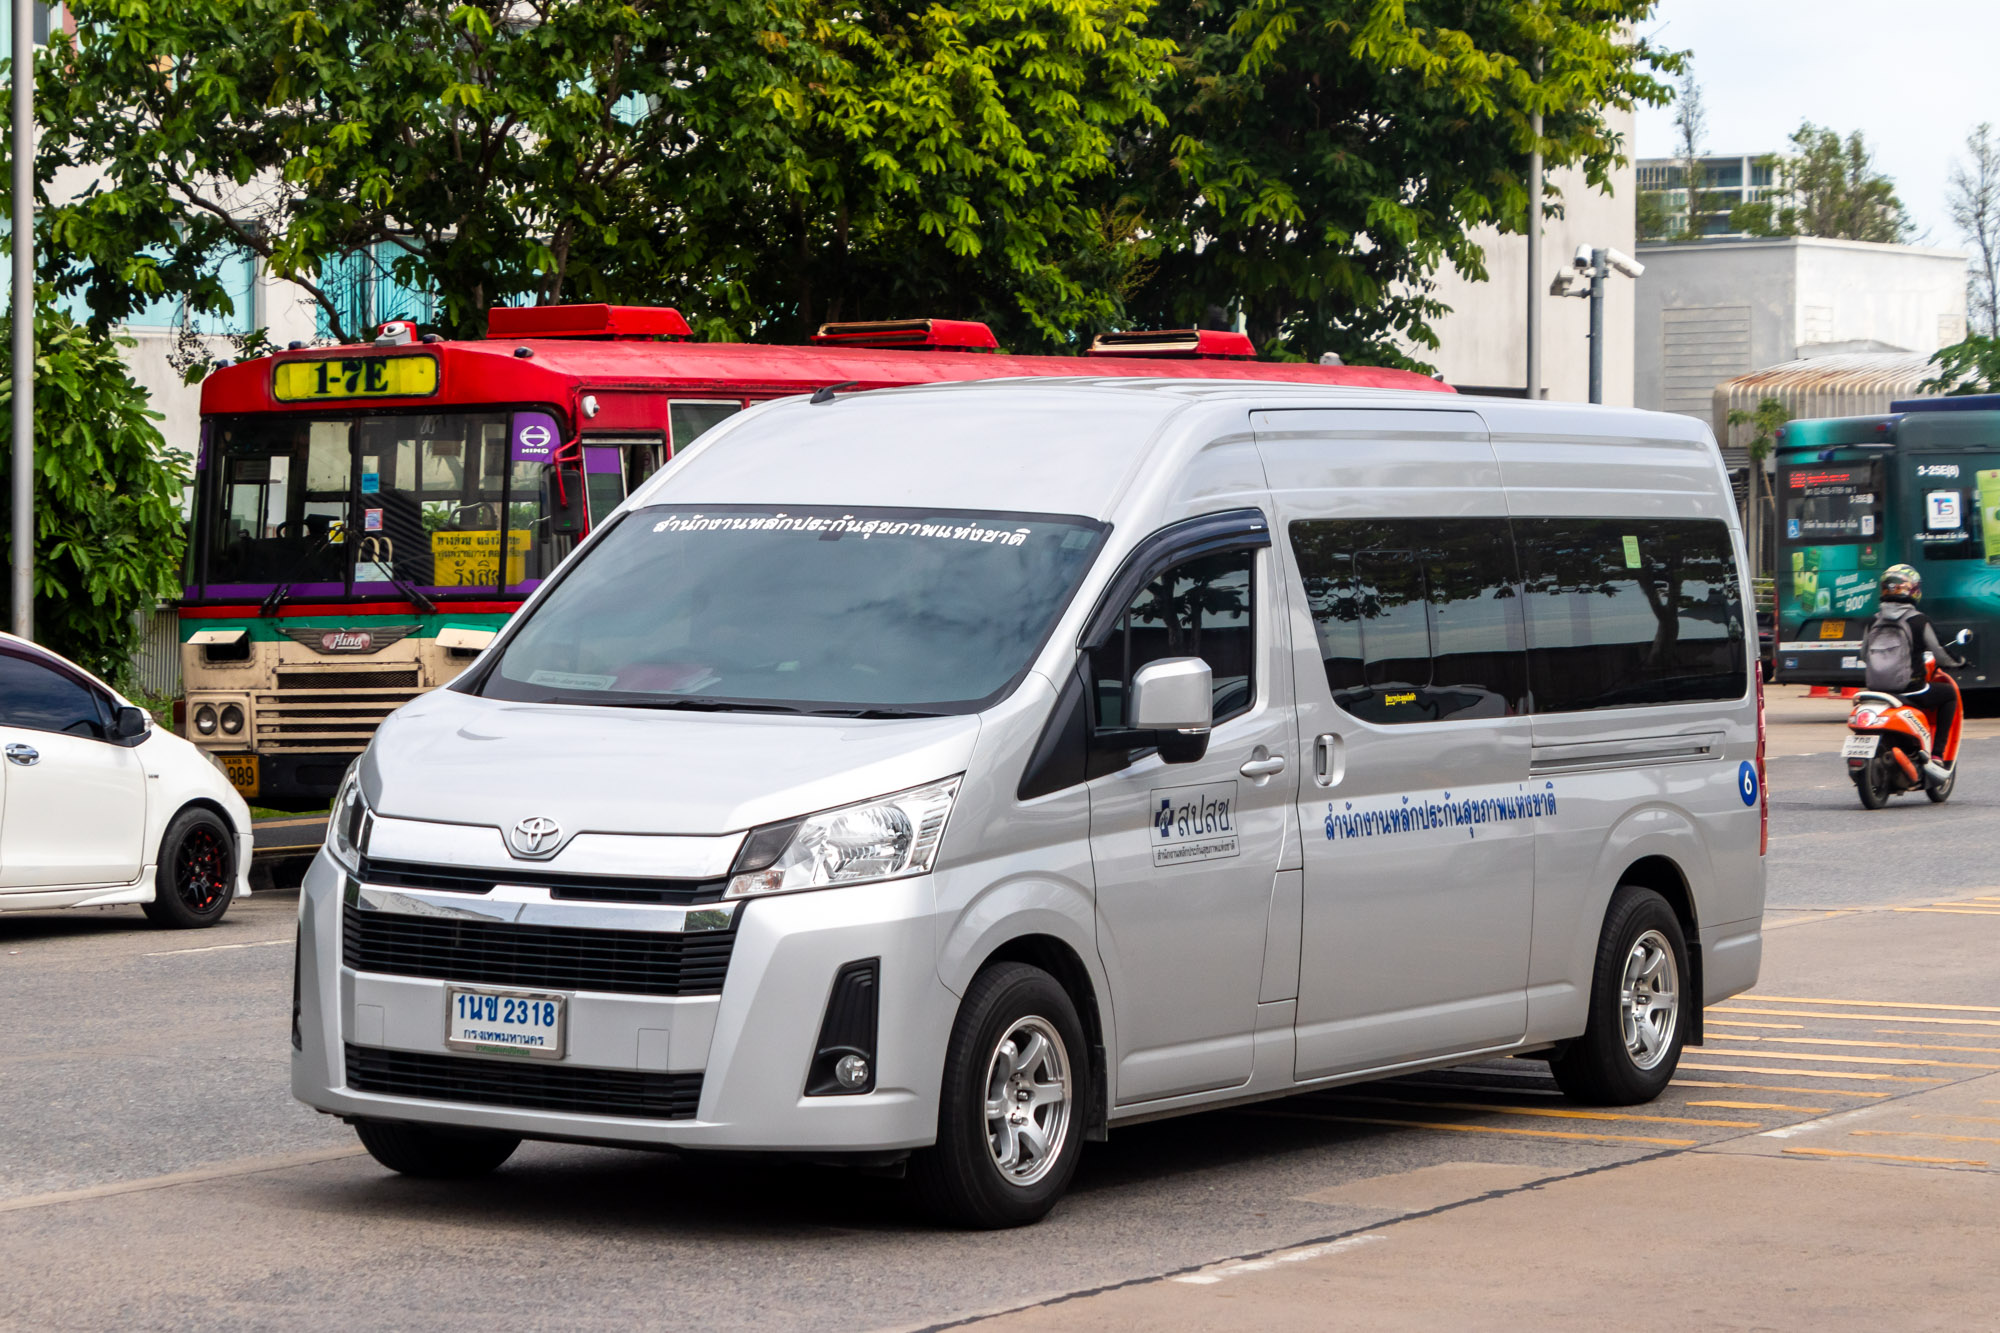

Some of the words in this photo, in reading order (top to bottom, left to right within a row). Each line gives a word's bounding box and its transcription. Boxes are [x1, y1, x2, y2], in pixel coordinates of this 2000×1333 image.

[315, 359, 389, 394] 1-7E
[652, 513, 1031, 547] สำนักงานหลักประกันสุขภาพแห่งชาติ
[329, 632, 363, 650] Hino
[228, 766, 254, 787] 989
[1744, 770, 1753, 795] 6
[1177, 794, 1233, 837] สปสช.
[1324, 781, 1557, 841] สำนักงานหลักประกันสุขภาพแห่งชาติ
[503, 998, 555, 1028] 2318
[463, 1028, 545, 1046] กรุงเทพมหานคร
